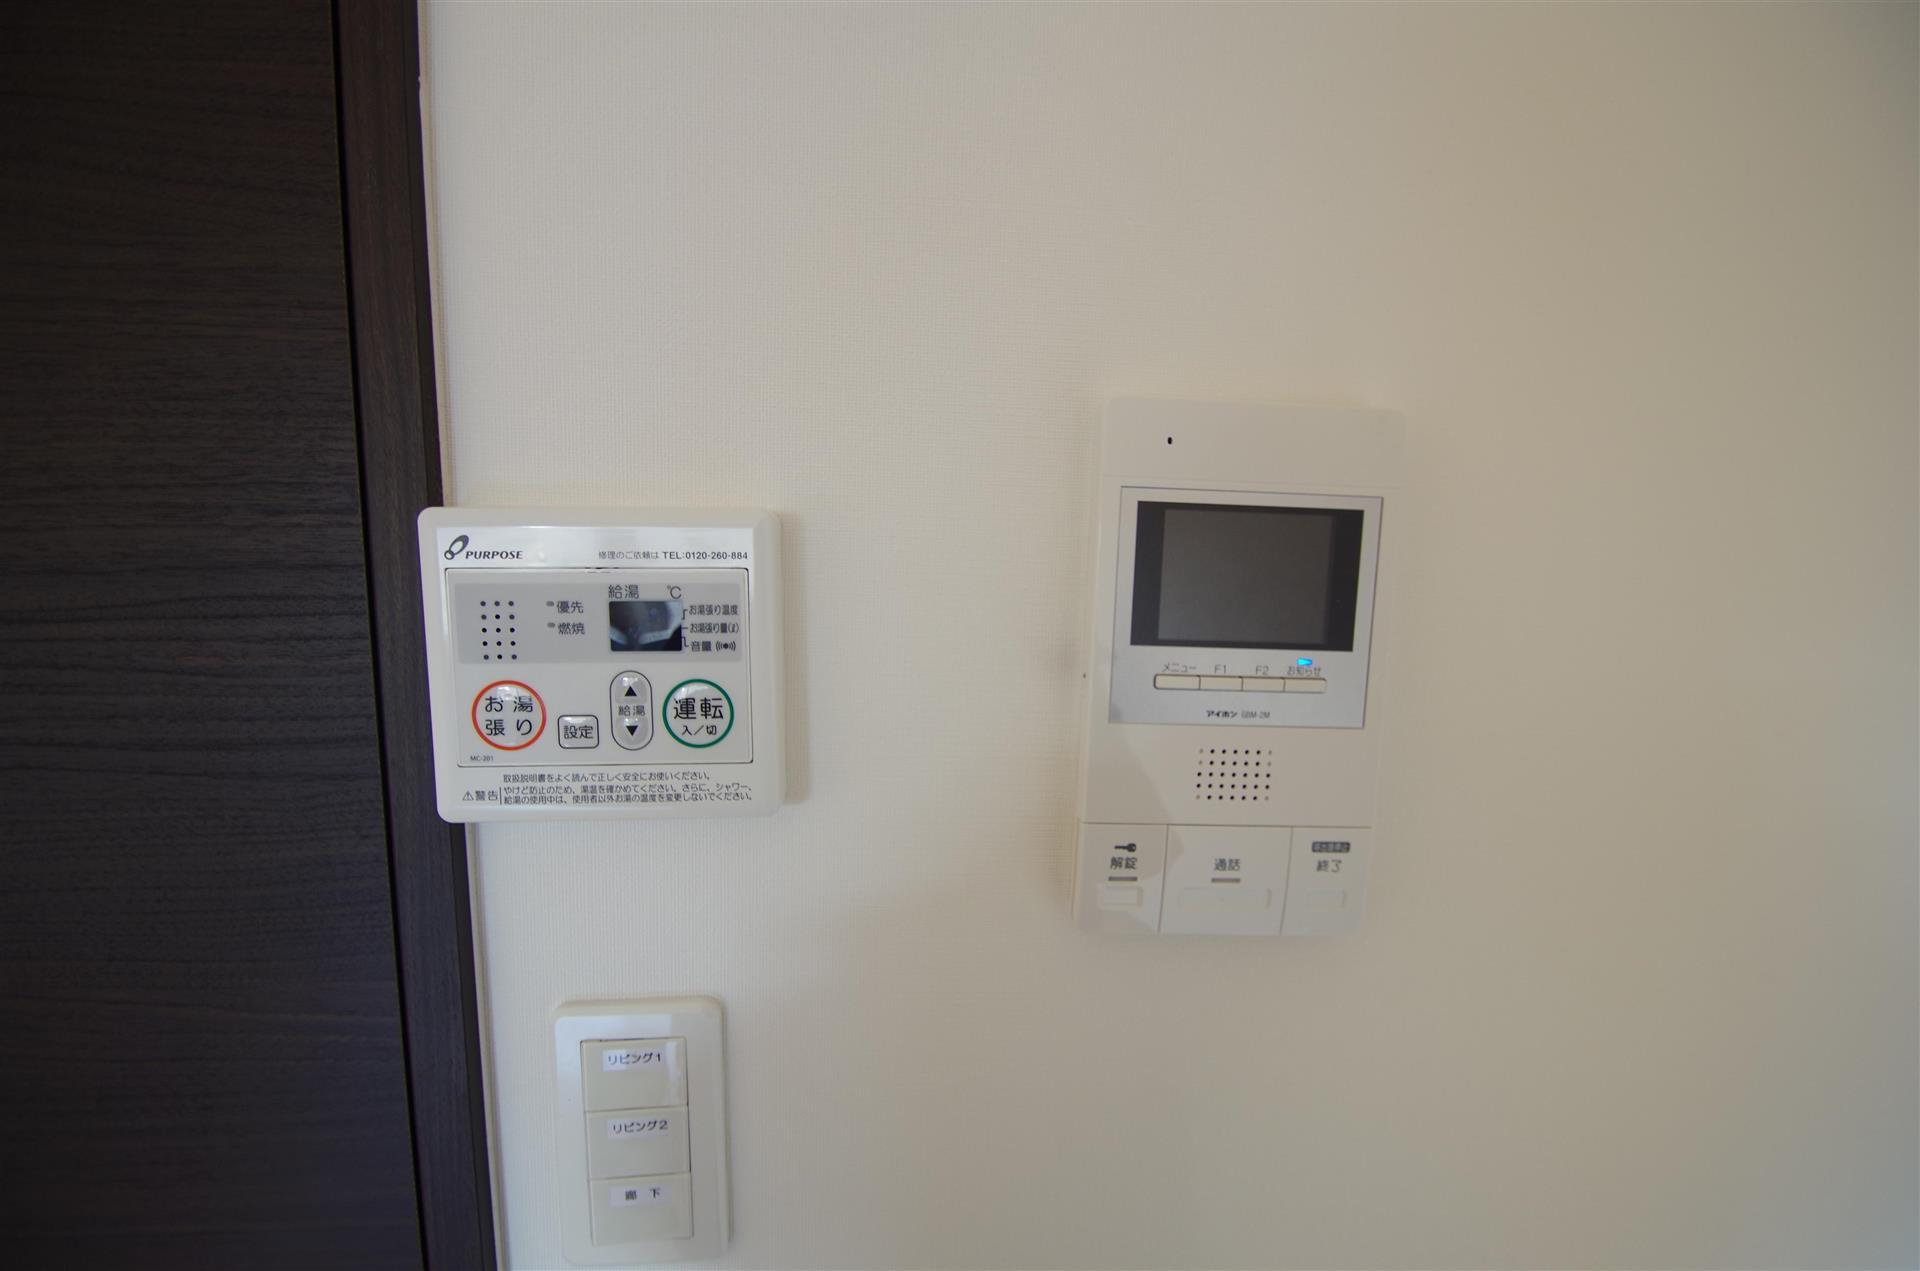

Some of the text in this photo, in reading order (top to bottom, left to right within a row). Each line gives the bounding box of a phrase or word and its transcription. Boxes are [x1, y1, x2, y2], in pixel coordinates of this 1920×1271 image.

[465, 550, 523, 560] PURPOSE
[608, 584, 640, 600] 給湯
[557, 600, 584, 615] 優先
[689, 604, 739, 616] お湯張り温度
[557, 622, 586, 636] 燃焼
[691, 641, 712, 652] 音量
[1161, 661, 1197, 673] メニュー
[1214, 664, 1227, 674] F1
[1255, 666, 1270, 676] F2
[1287, 666, 1322, 677] お知らせ
[618, 705, 646, 717] 給湯
[673, 697, 724, 720] 運転
[1206, 710, 1238, 719] アイホン
[563, 725, 594, 740] 設定
[475, 791, 499, 801] 警告
[1110, 856, 1138, 870] 解錠
[1213, 858, 1241, 872] 通話
[1316, 859, 1343, 873] 終了
